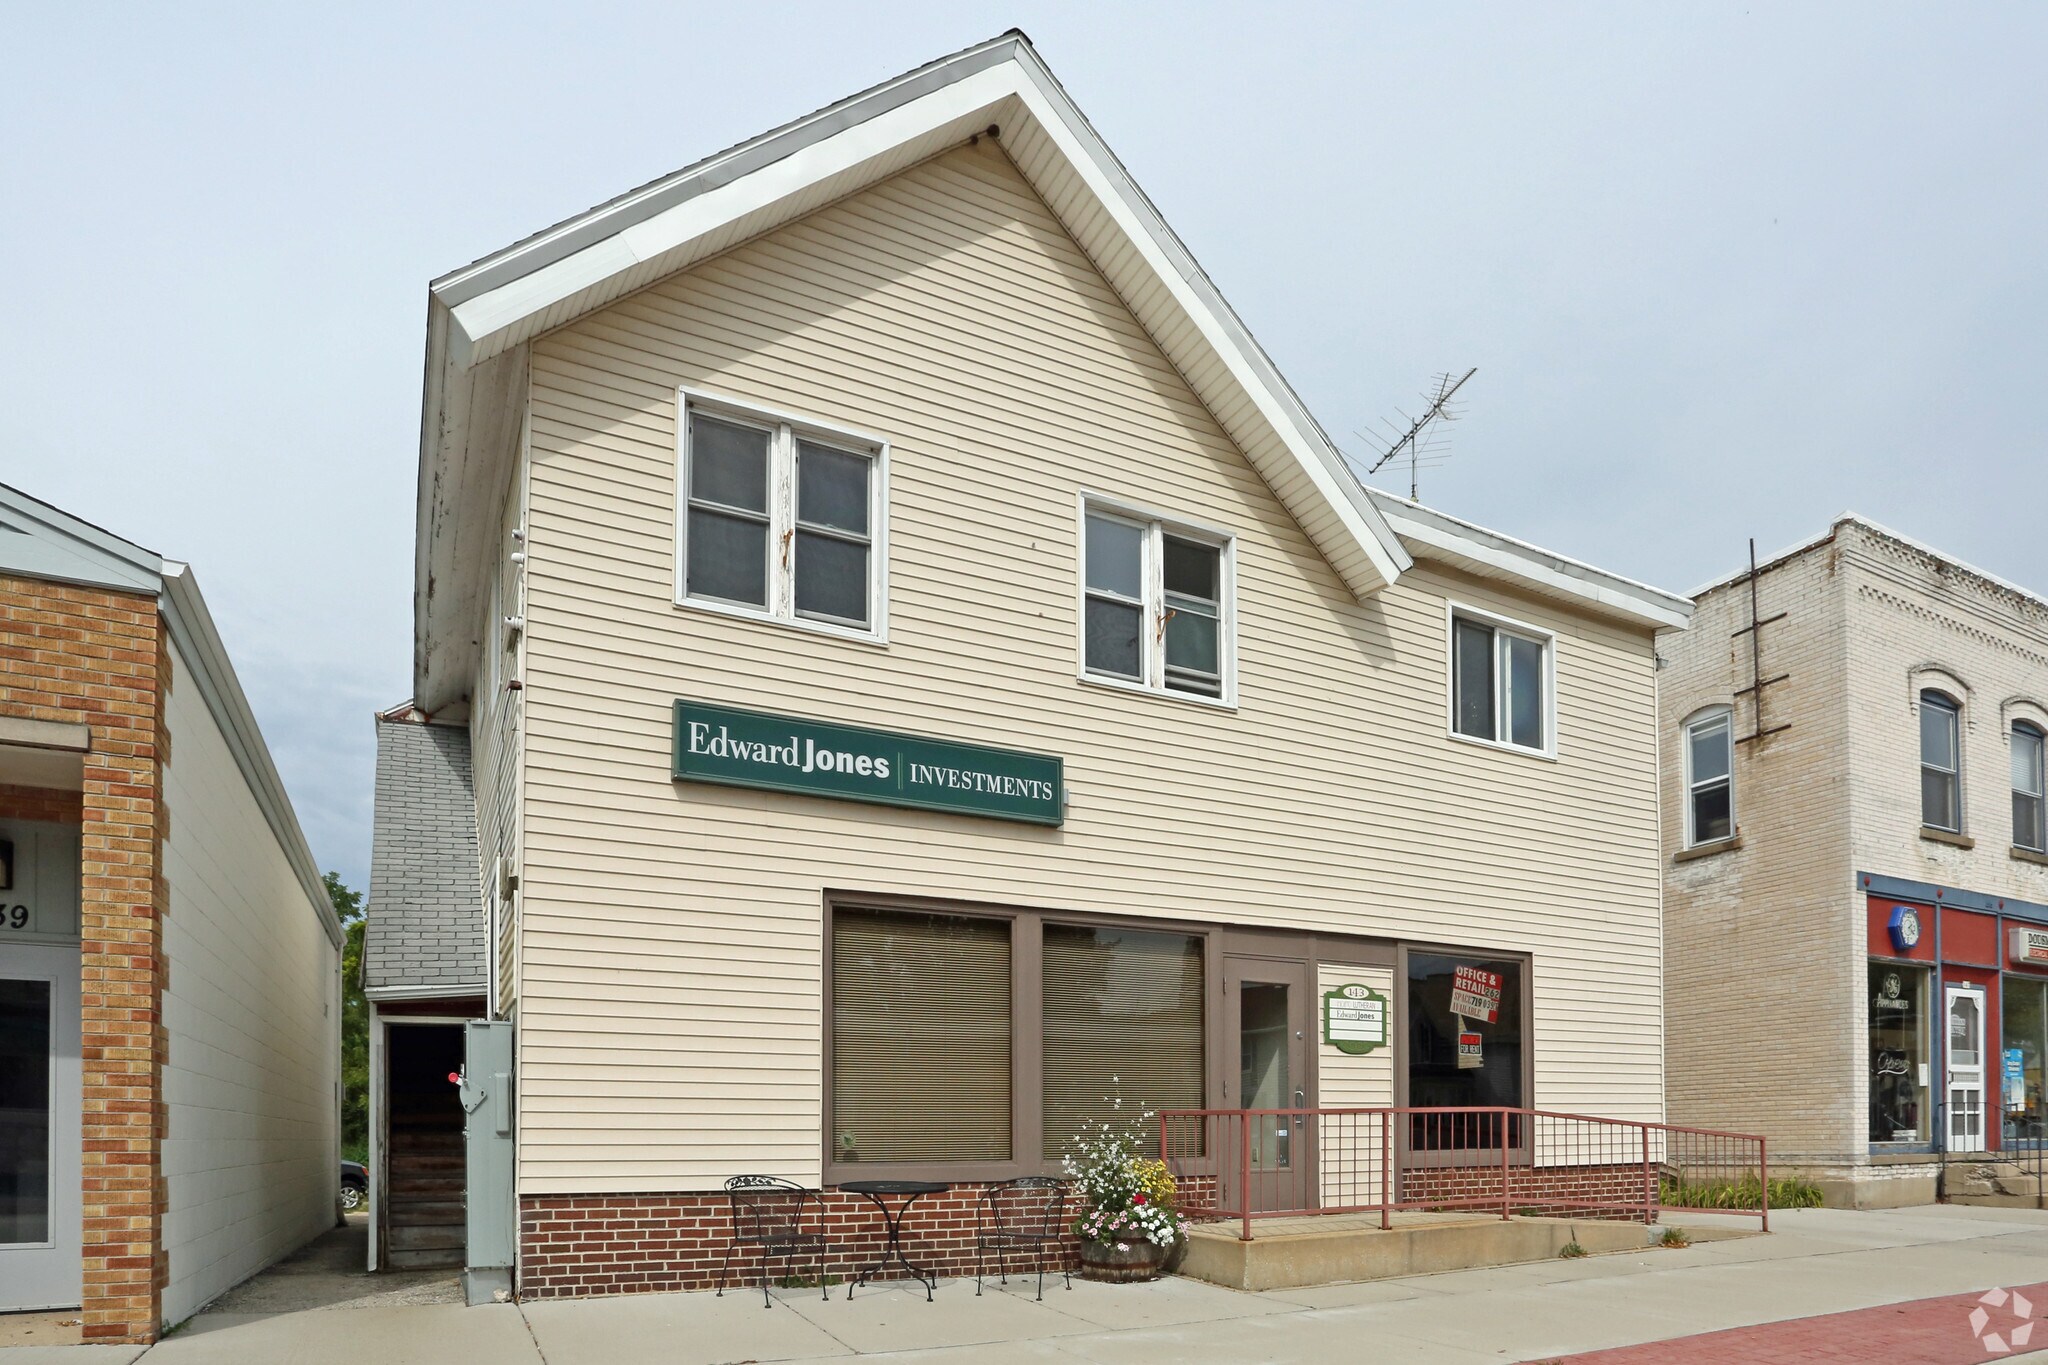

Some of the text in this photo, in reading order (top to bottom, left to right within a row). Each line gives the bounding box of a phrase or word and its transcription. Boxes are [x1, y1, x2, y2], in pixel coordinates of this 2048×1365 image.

[909, 763, 1053, 801] INVESTMENTS
[1456, 965, 1496, 986] OFFICE &
[1348, 987, 1365, 998] 143
[1455, 977, 1486, 995] RETAIL
[1484, 987, 1500, 998] 262
[1453, 1001, 1482, 1017] AVAILABLE
[1471, 996, 1482, 1007] 719
